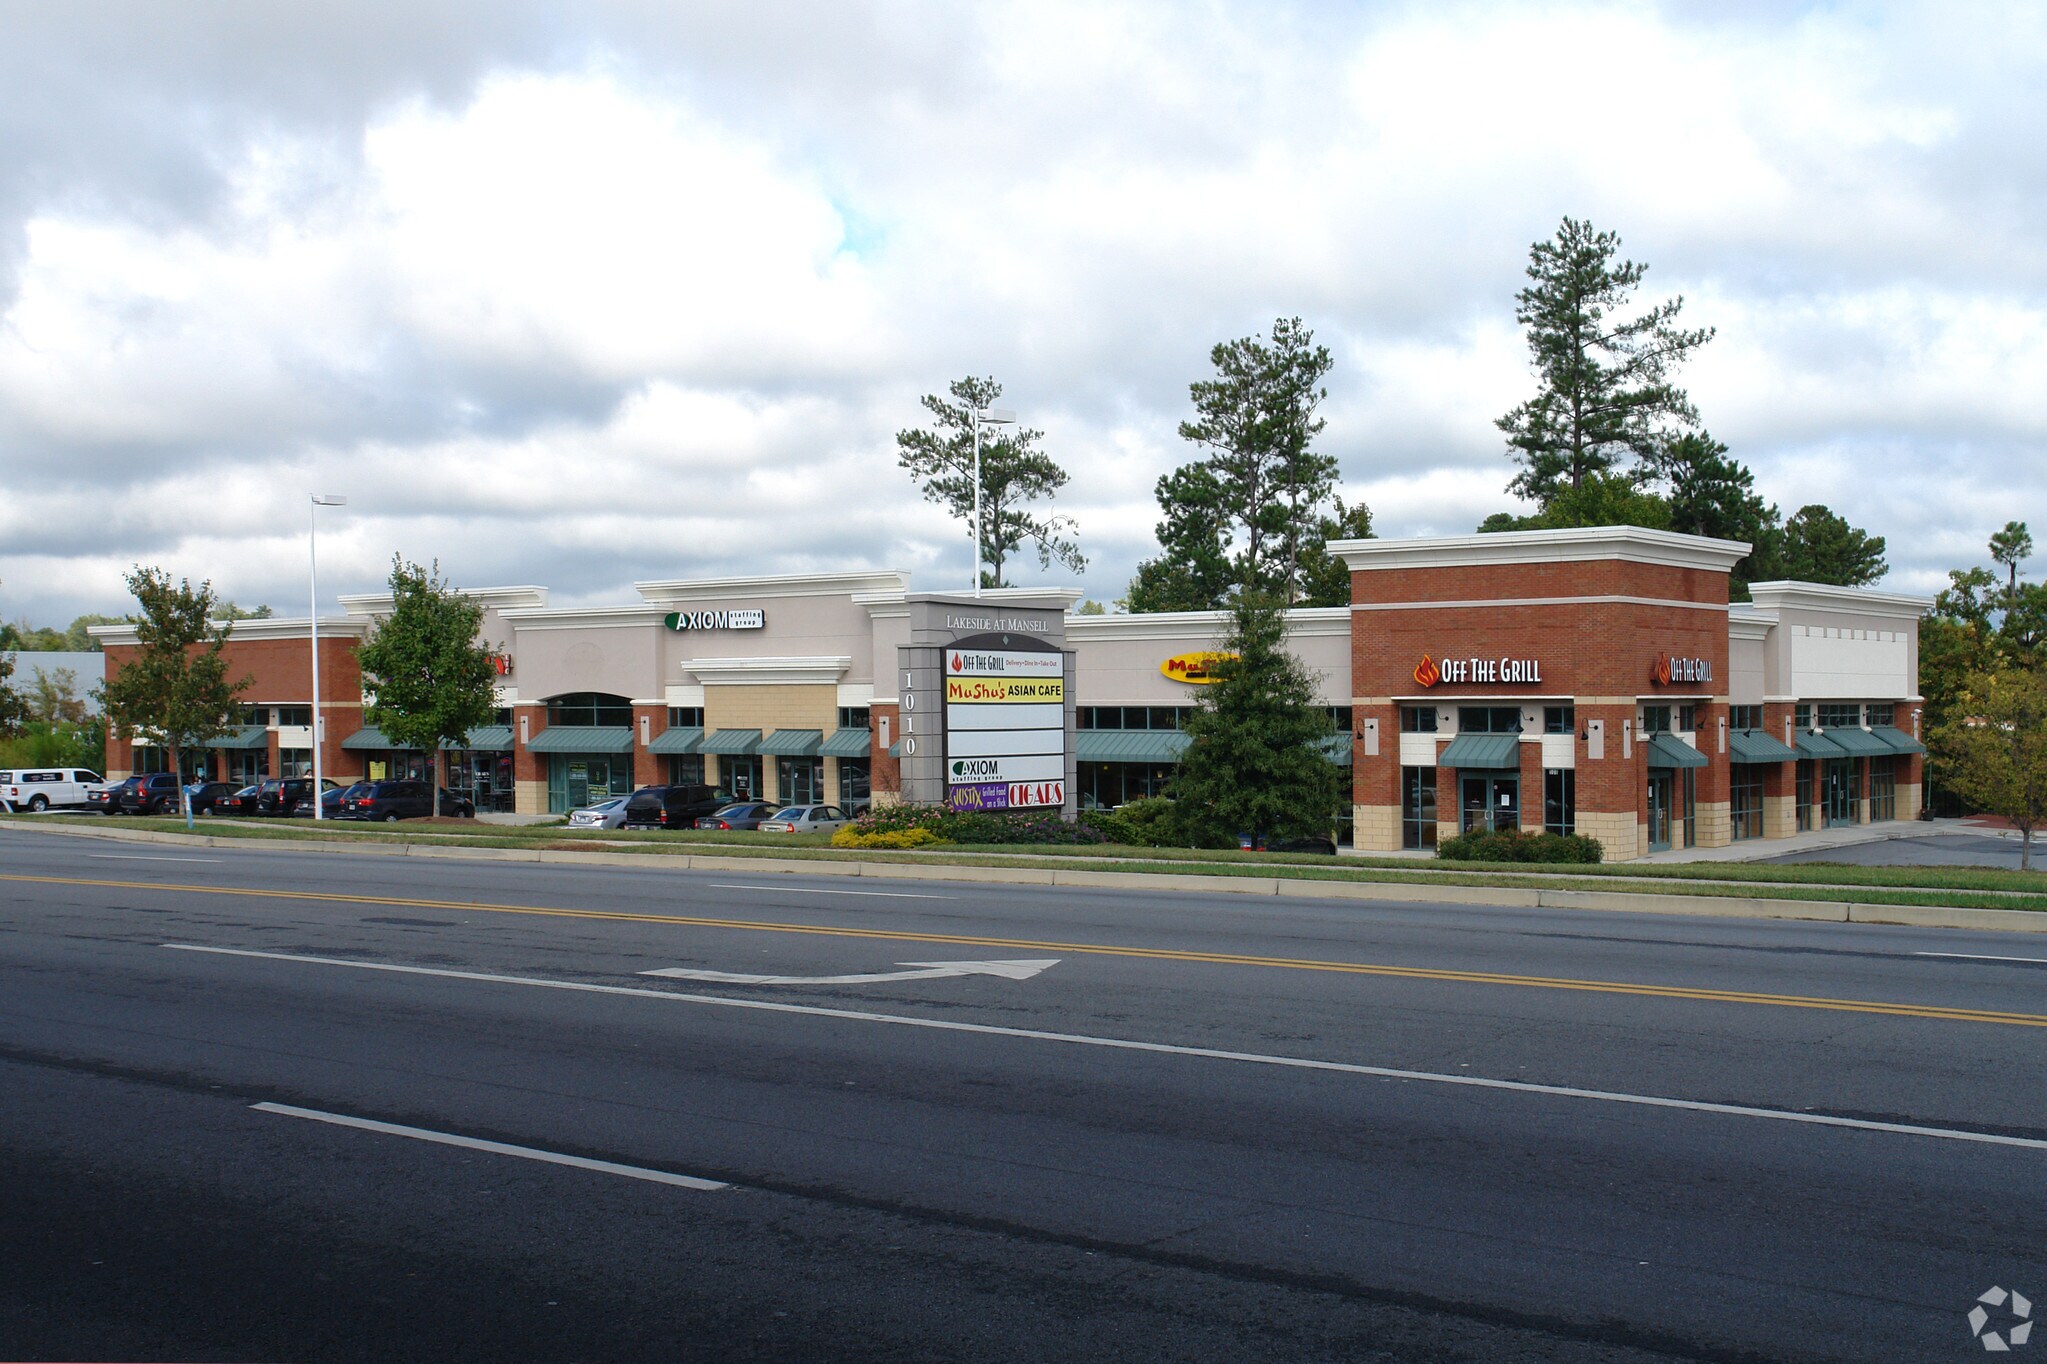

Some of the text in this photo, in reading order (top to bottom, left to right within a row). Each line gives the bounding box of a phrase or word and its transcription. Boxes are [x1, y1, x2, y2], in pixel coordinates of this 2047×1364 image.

[676, 611, 728, 631] AXIOM
[947, 615, 1049, 632] LAKESIDE AT MANSELL
[963, 655, 1004, 671] OFF THE GRILL
[1441, 657, 1542, 683] OFF THE GRILL
[1670, 656, 1712, 681] OFF THE GRILL
[949, 681, 1061, 700] MuShu's ASIAN CAFE
[961, 760, 998, 775] AXIOM
[1010, 783, 1063, 806] CIGARS
